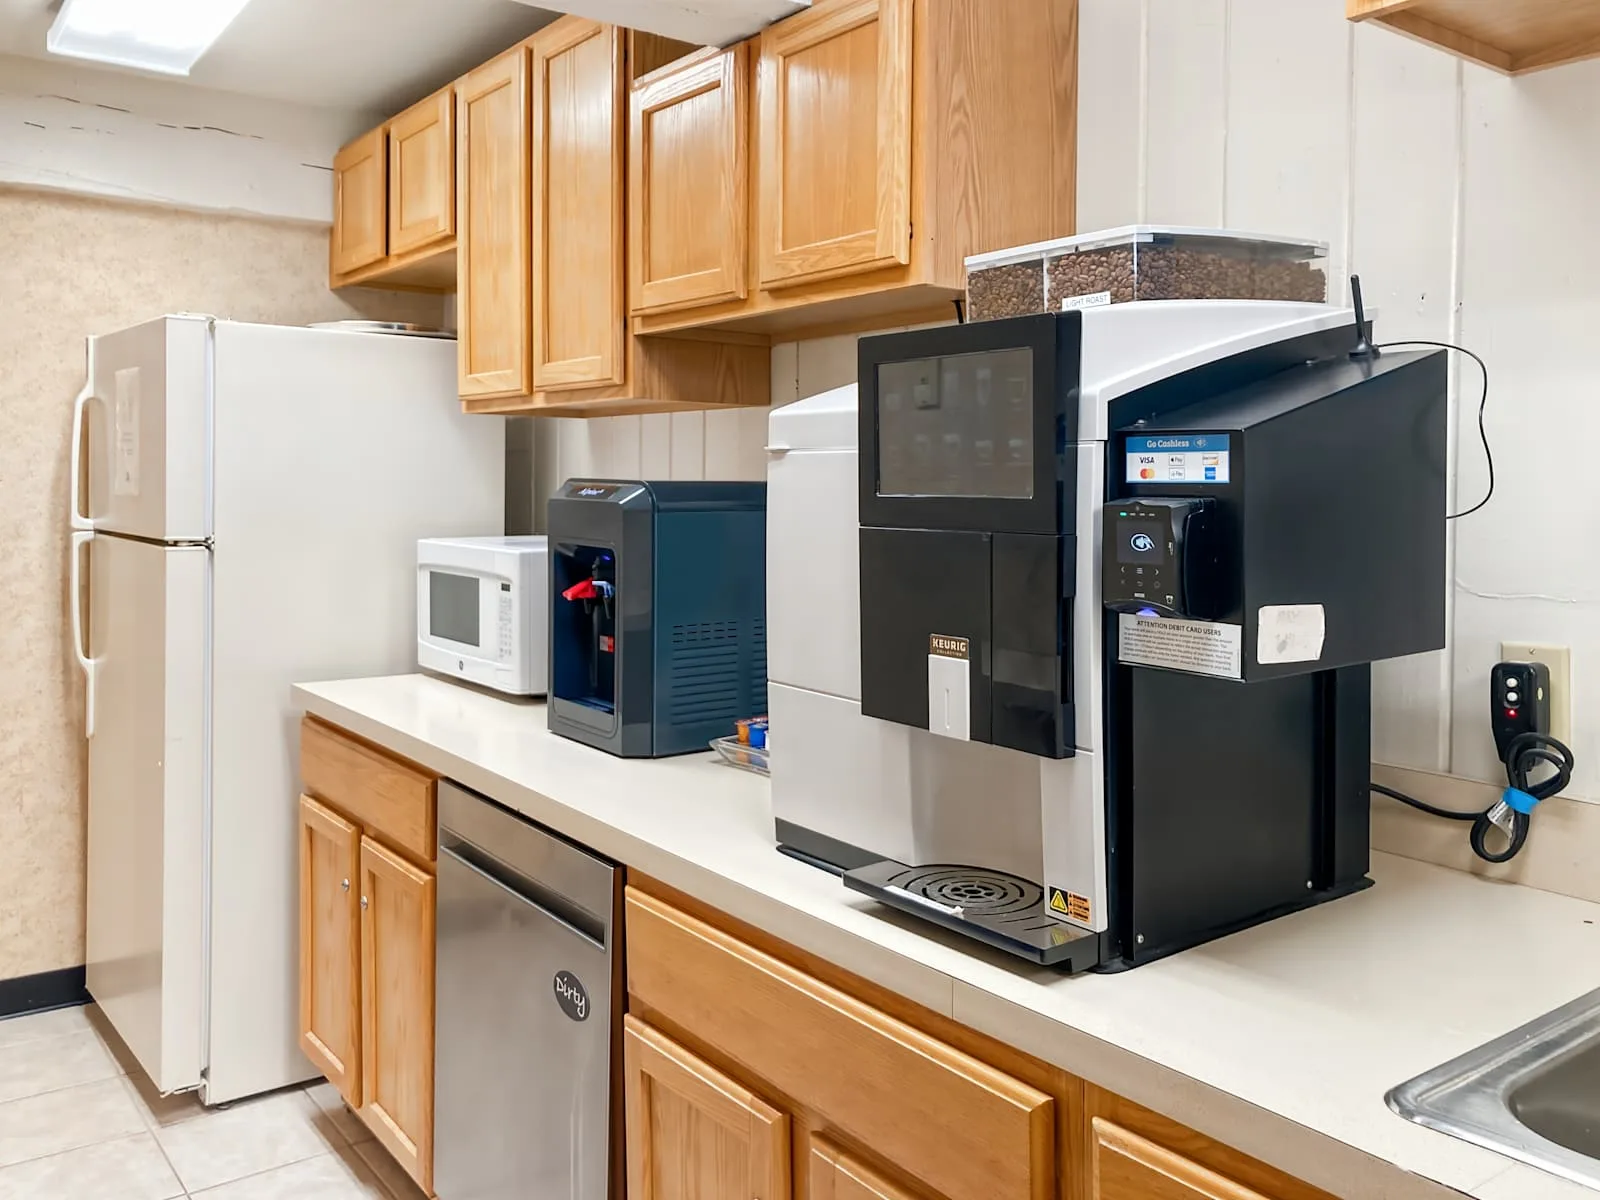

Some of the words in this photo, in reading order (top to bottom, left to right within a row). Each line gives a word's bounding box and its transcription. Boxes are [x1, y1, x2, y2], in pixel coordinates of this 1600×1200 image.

[1065, 298, 1084, 308] LIGHT
[1086, 294, 1108, 305] ROAST
[1146, 440, 1157, 448] Go
[1158, 439, 1189, 448] Cashless
[1139, 456, 1155, 464] VISA
[1136, 620, 1168, 631] ATTENTION
[1168, 624, 1185, 632] DEBIT
[1186, 626, 1203, 634] CARD
[1203, 628, 1221, 636] USERS
[932, 638, 966, 652] KEURIG
[556, 977, 585, 1018] Dirty
